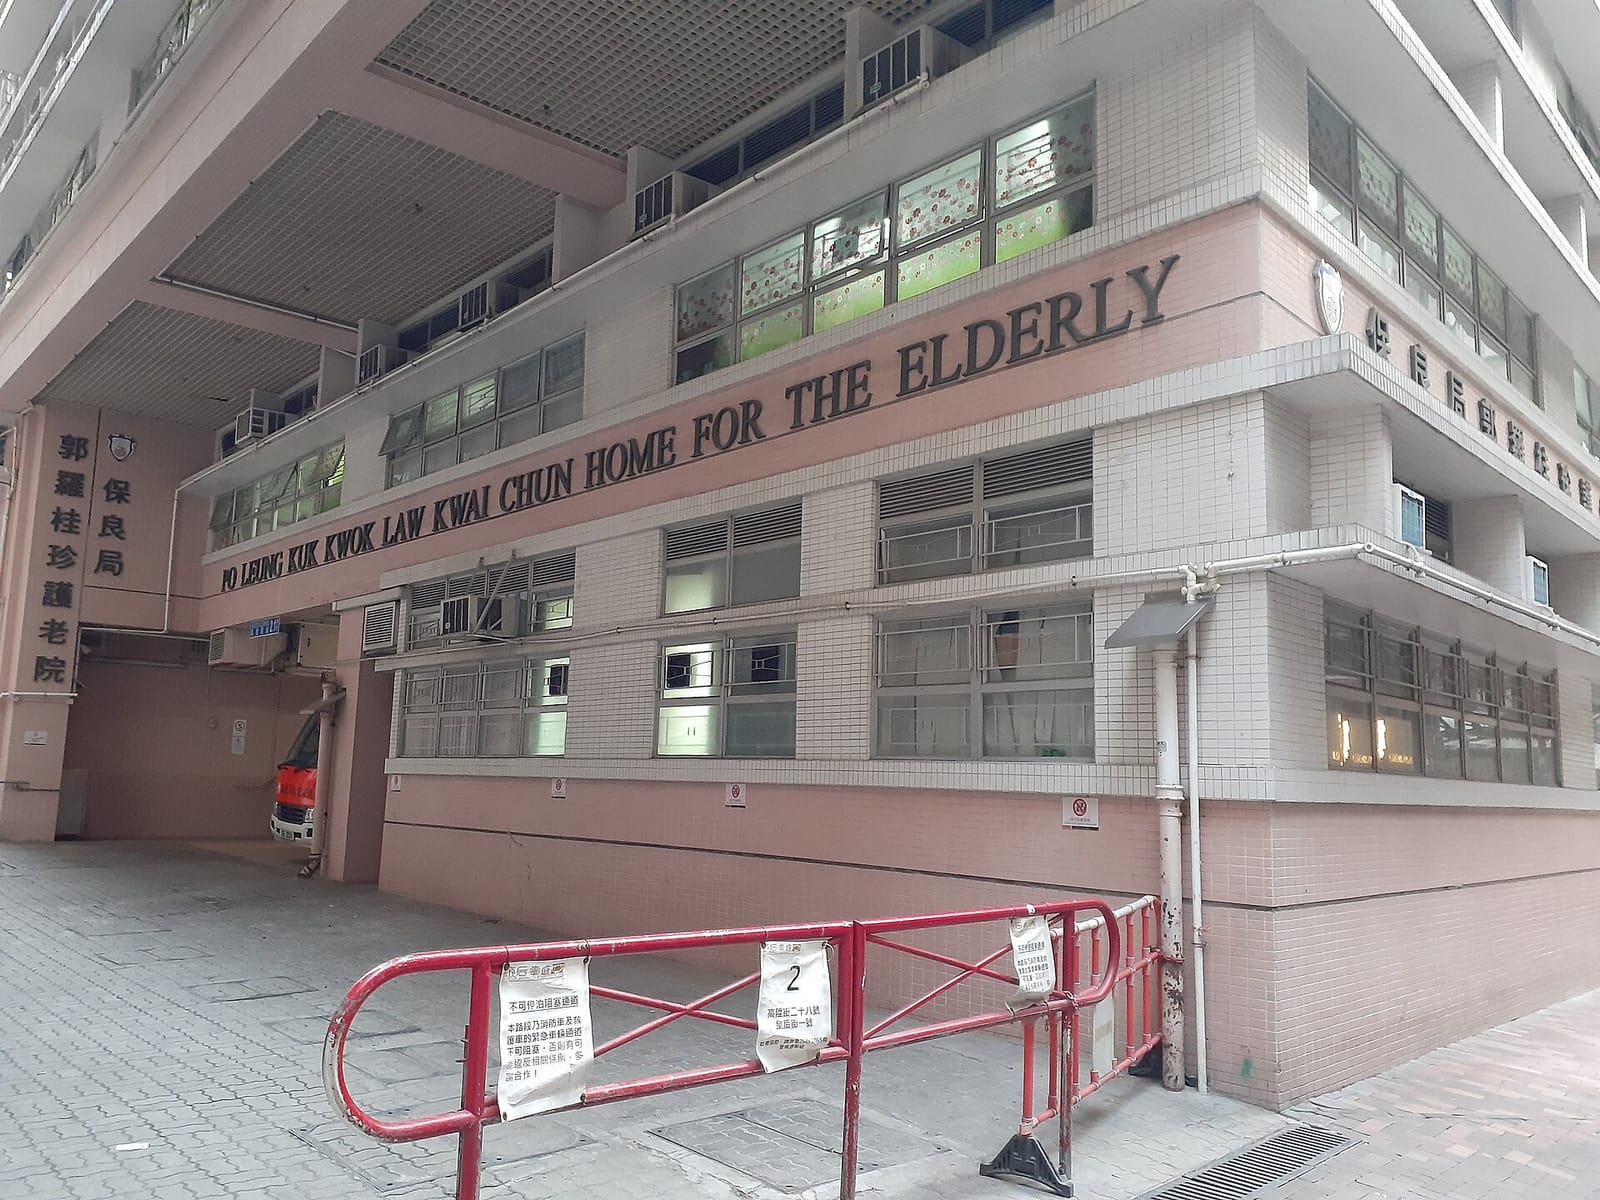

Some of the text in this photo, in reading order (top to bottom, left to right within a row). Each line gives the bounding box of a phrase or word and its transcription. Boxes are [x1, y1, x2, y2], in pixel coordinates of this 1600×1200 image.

[222, 254, 1180, 592] PO LEUNG KUK KWOK LAW KWAI CHUN HOME FOR THE ELDERLY
[33, 433, 89, 684] 郭羅桂珍護老院
[94, 477, 131, 577] 保良局
[787, 965, 801, 991] 2
